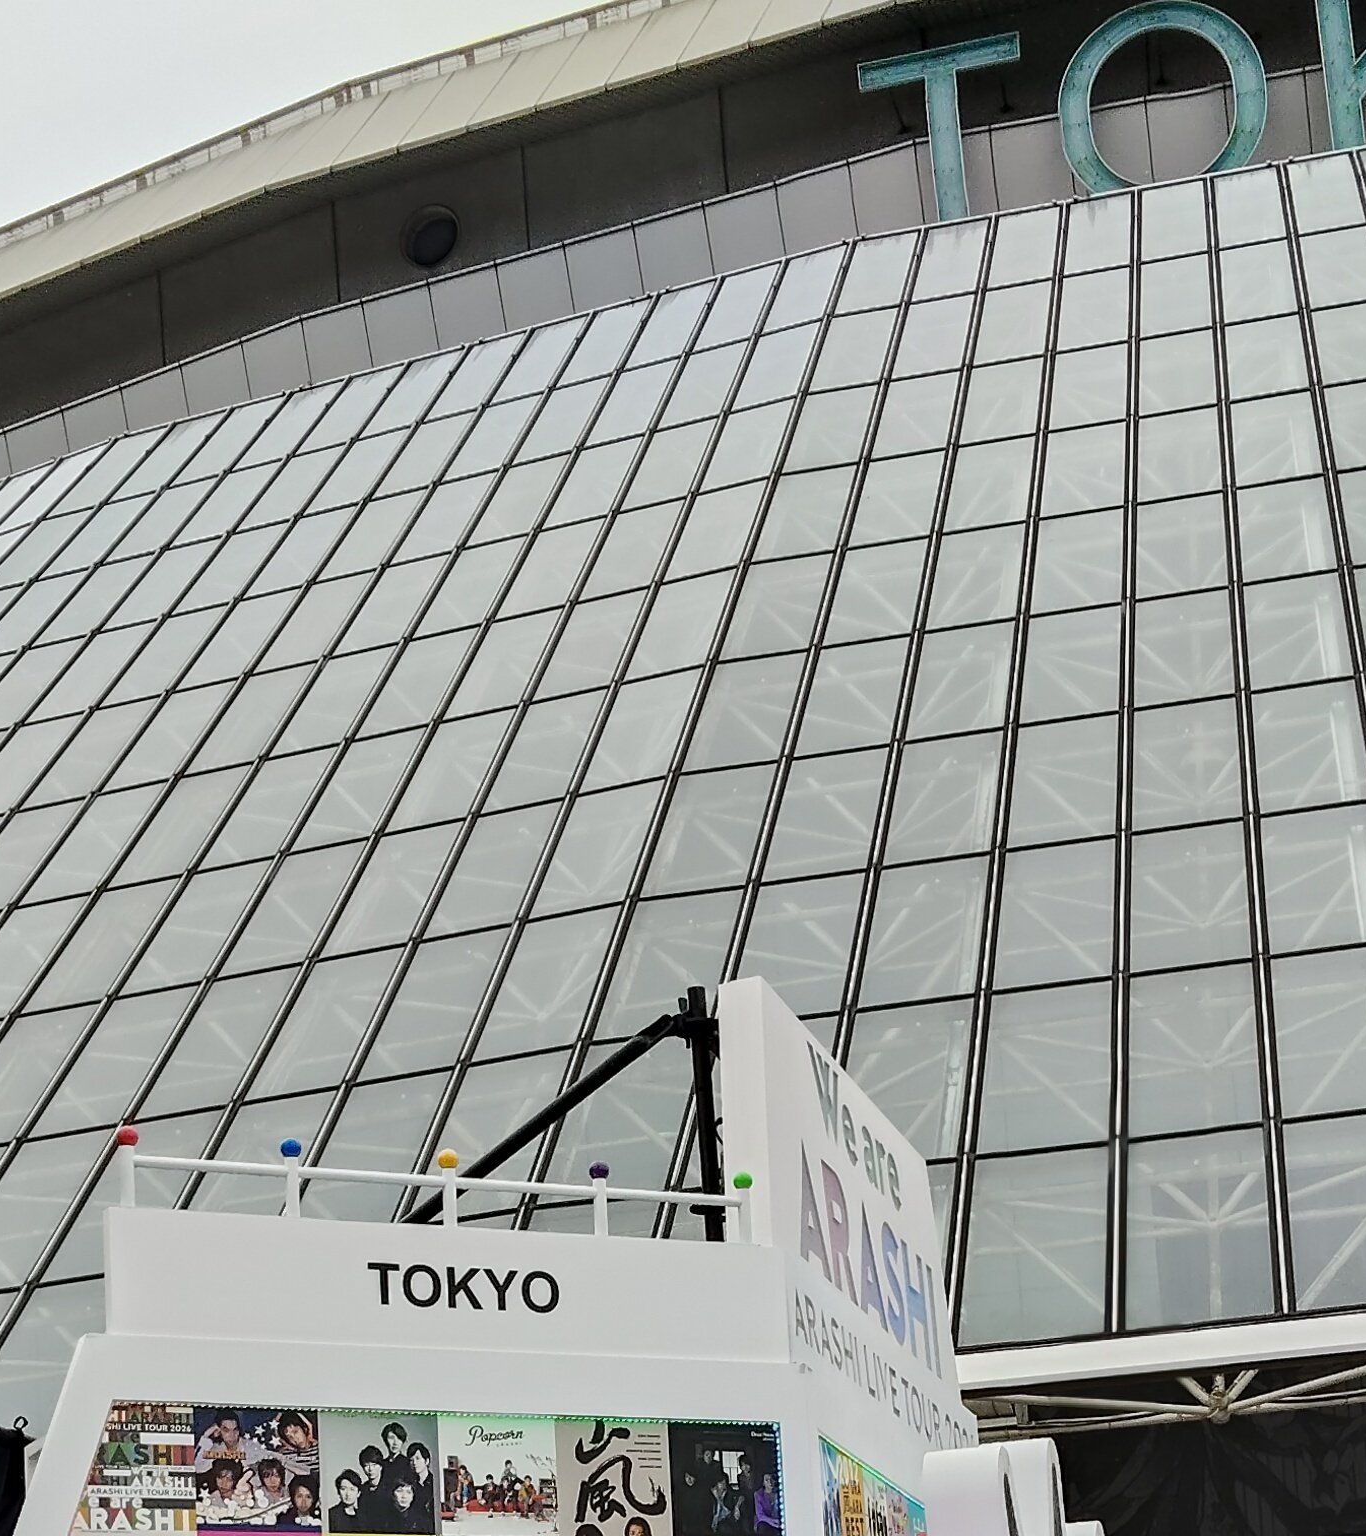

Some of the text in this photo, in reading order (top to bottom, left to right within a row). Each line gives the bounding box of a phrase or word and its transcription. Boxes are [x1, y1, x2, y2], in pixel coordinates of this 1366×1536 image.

[806, 1040, 902, 1211] We are
[800, 1139, 942, 1379] ARASHI
[368, 1262, 560, 1313] TOKYO
[795, 1288, 862, 1387] ARASHI
[863, 1345, 901, 1418] LIVE
[902, 1375, 940, 1449] TOUR
[123, 1423, 141, 1431] LIVE
[145, 1424, 168, 1432] TOUR
[464, 1424, 524, 1447] Popcorn
[131, 1476, 194, 1488] ARASHI
[110, 1497, 143, 1508] are
[73, 1508, 191, 1531] ARASHI
